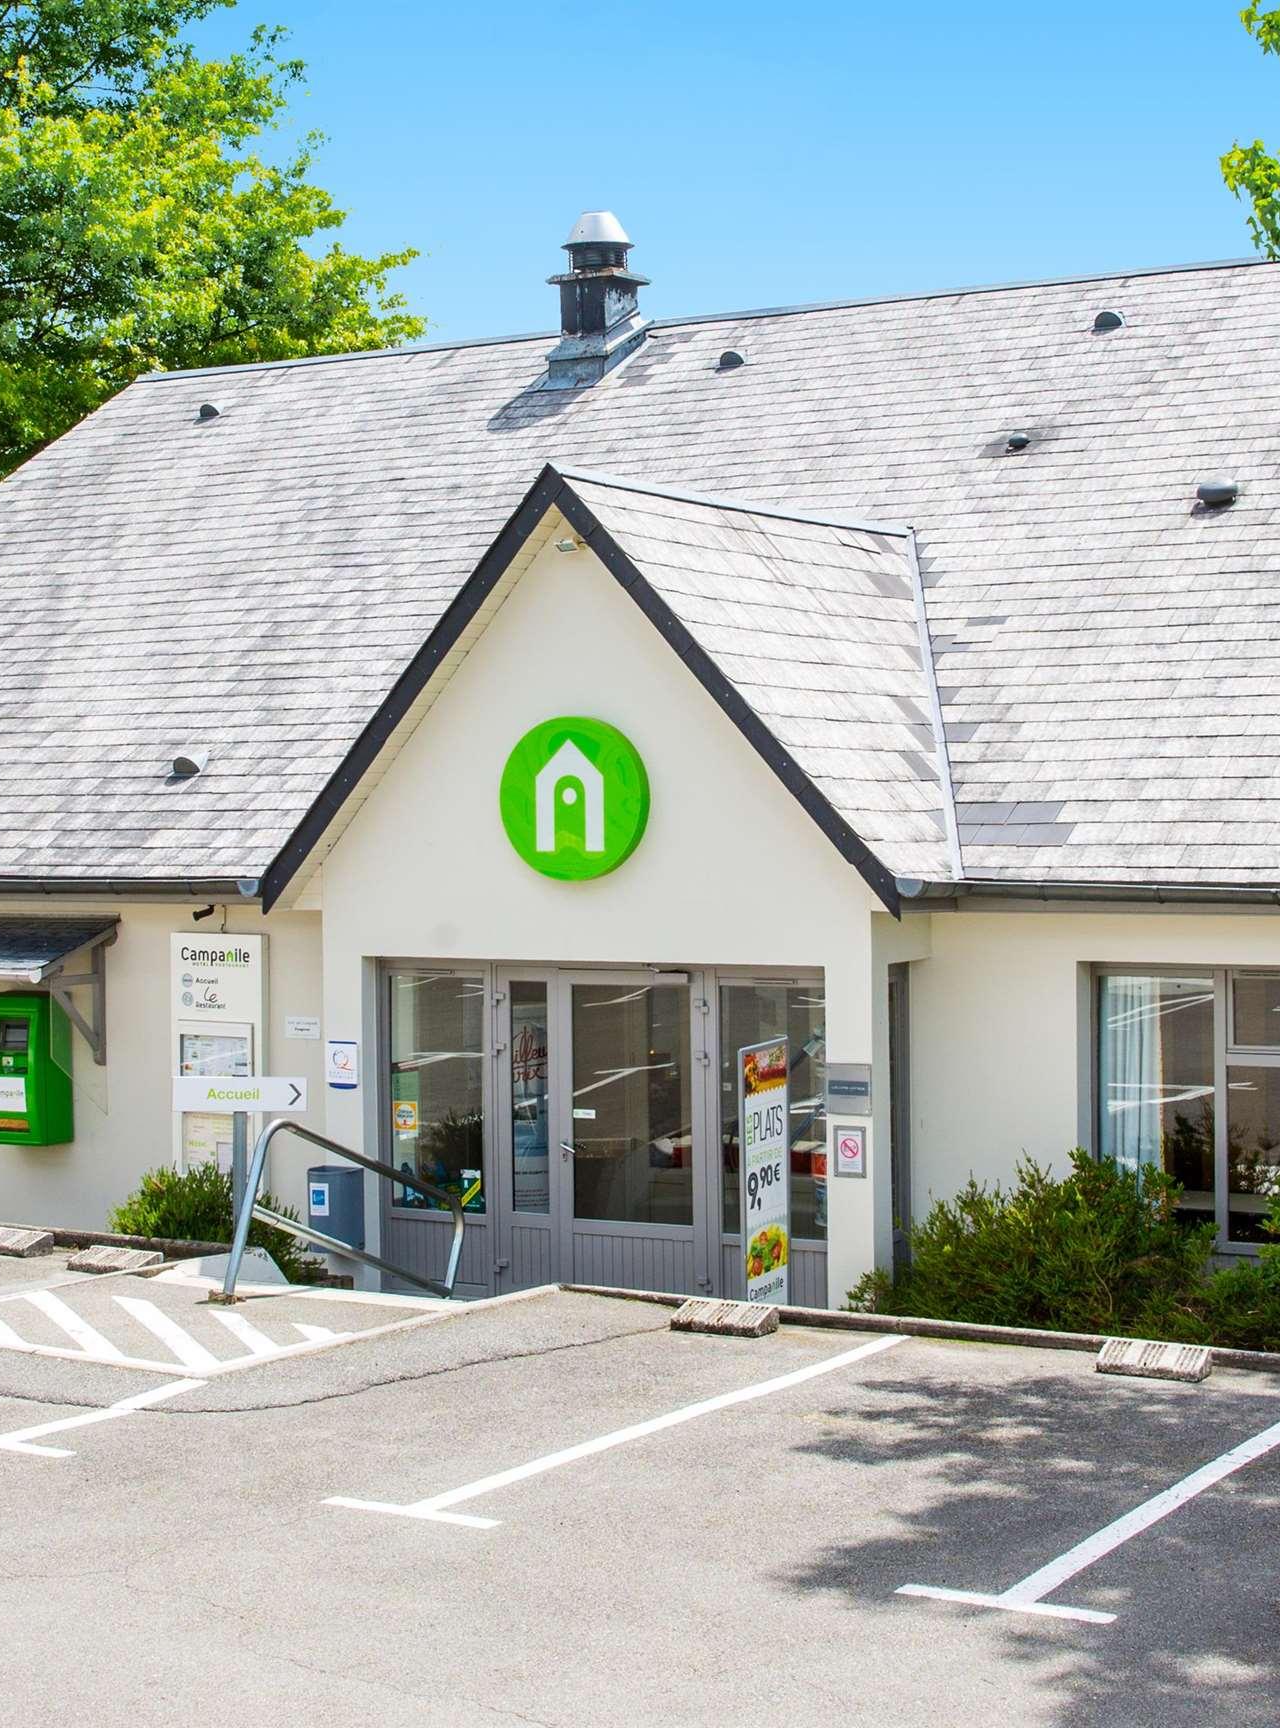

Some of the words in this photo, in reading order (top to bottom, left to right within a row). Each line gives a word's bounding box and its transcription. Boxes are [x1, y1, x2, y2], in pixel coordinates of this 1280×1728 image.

[181, 946, 250, 966] Campanile
[207, 1088, 260, 1100] Accueil
[753, 1104, 783, 1144] PLATS
